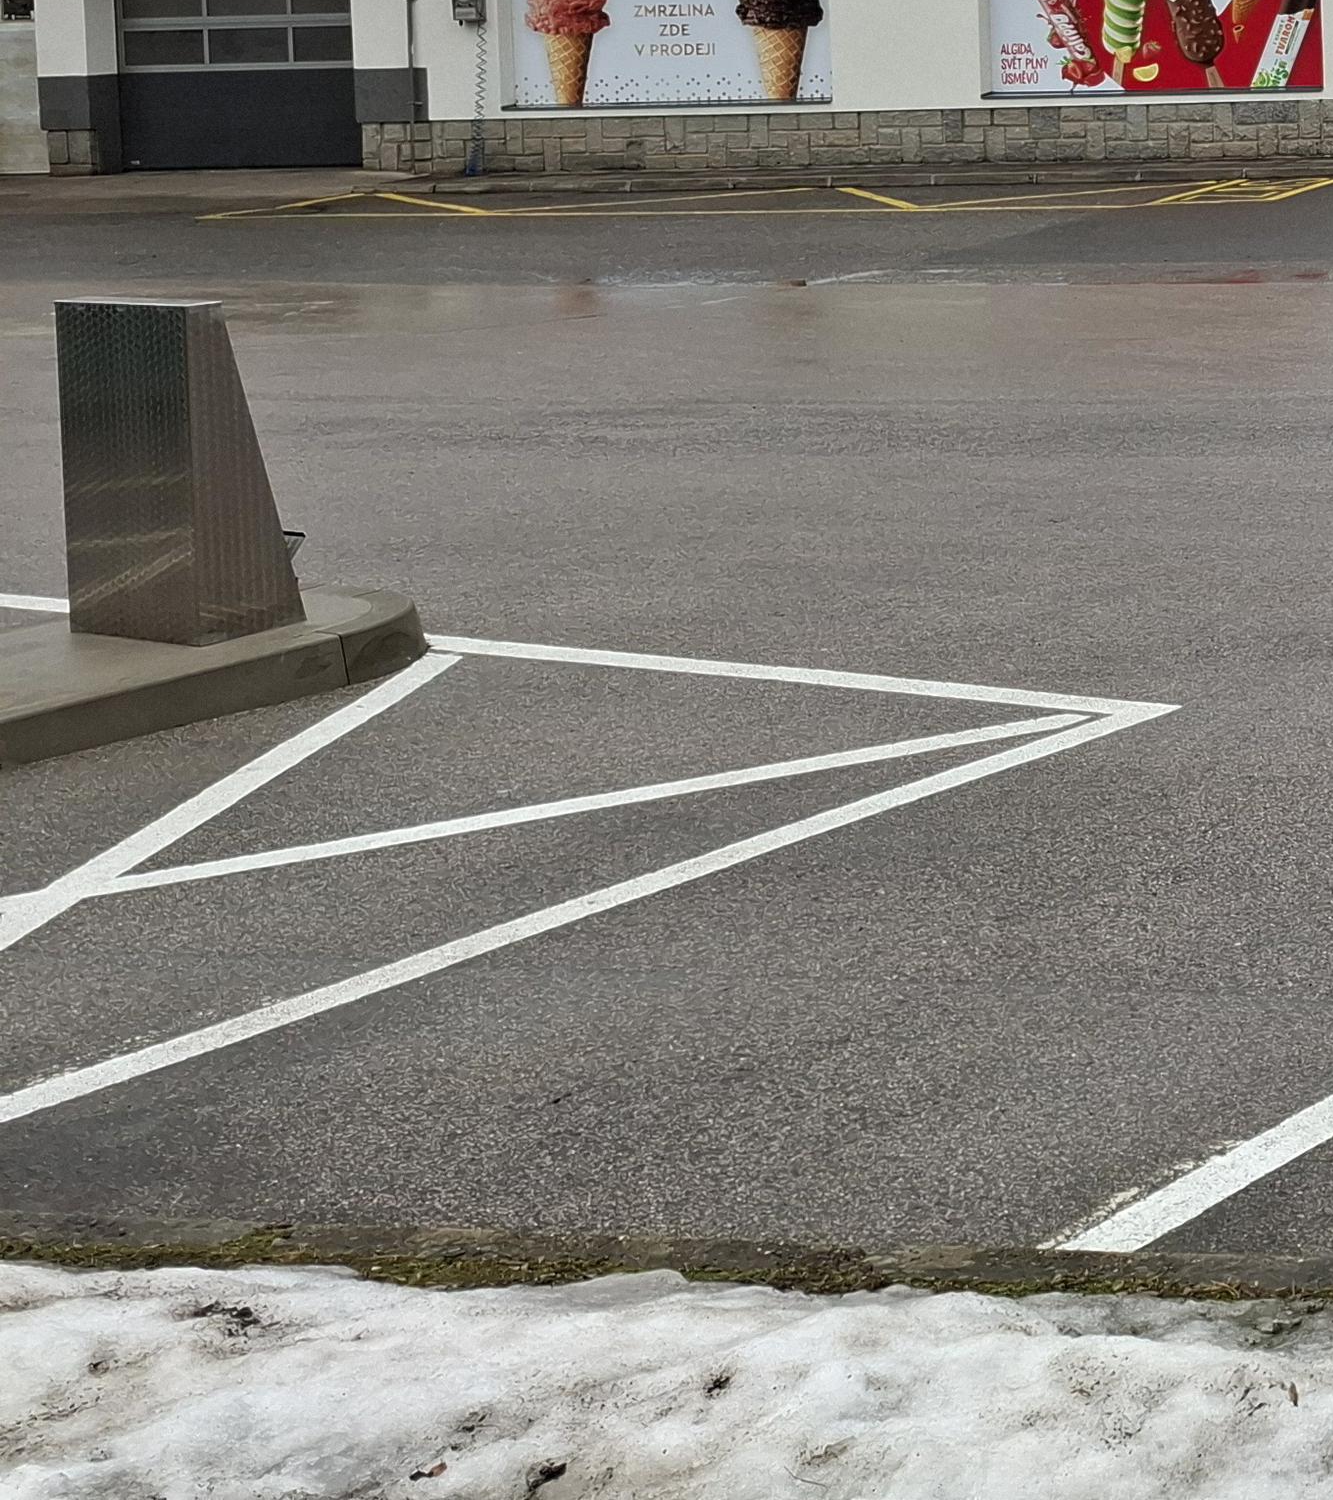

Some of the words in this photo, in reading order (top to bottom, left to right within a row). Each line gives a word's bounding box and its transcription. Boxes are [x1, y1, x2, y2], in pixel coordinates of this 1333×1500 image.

[633, 4, 715, 18] ZMRZLINA
[659, 23, 691, 37] ZDE
[634, 43, 645, 56] V
[650, 43, 716, 56] PRODEJI
